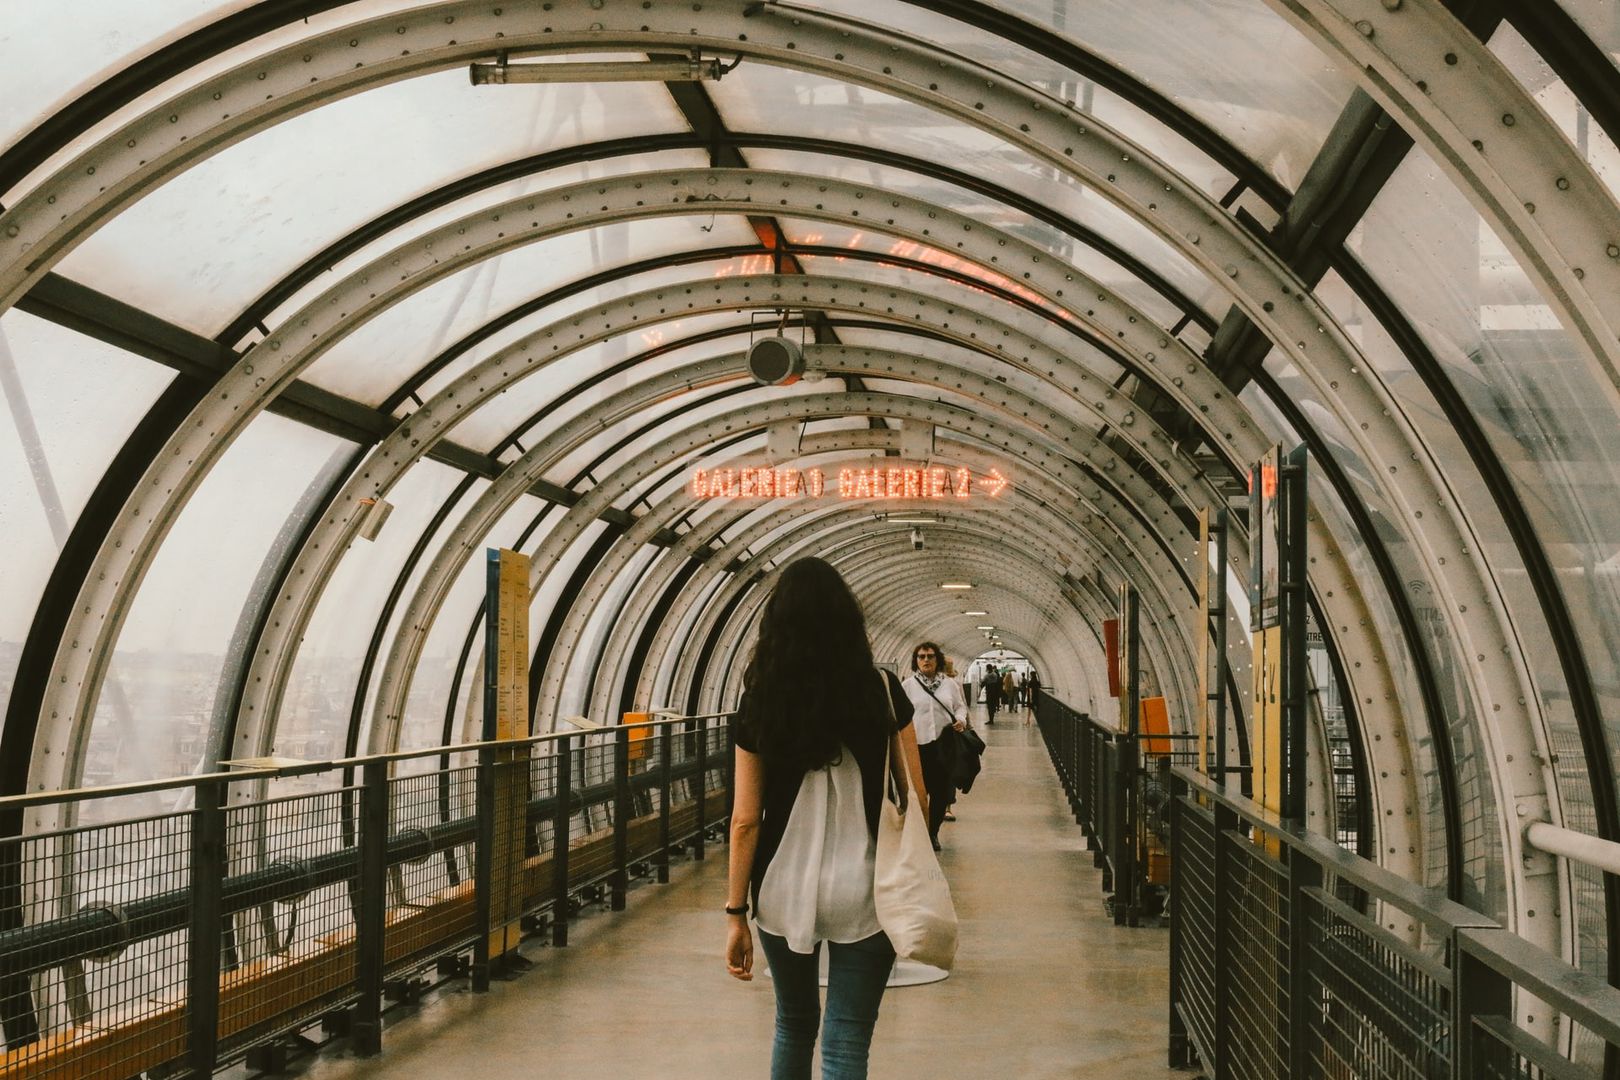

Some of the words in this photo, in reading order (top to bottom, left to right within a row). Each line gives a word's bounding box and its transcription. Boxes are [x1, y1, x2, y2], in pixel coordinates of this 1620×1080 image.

[693, 467, 798, 498] GALERIE
[838, 467, 945, 498] GALERIE
[956, 467, 971, 498] 2
